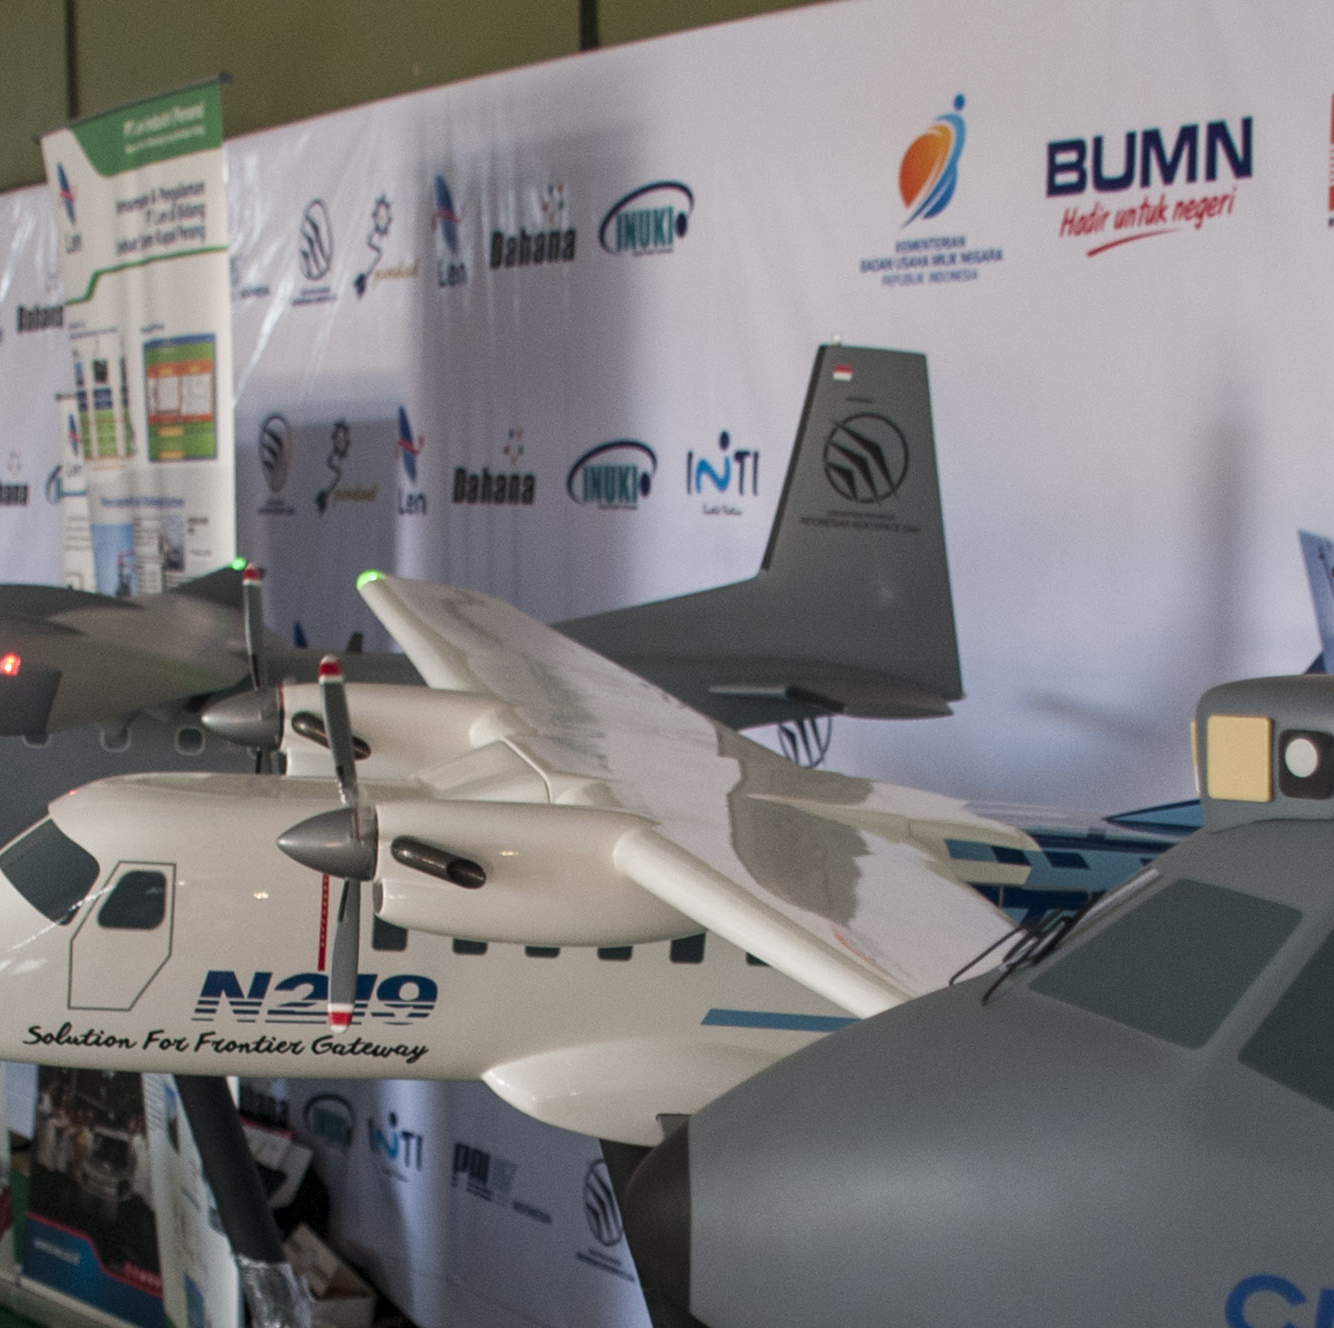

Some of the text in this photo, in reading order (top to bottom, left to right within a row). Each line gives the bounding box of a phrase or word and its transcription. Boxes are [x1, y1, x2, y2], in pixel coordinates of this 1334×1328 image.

[1046, 115, 1254, 198] BUMN
[615, 204, 674, 251] INUKI
[1059, 186, 1238, 239] Hadir untuk negeri
[489, 226, 576, 270] Dahana
[437, 258, 466, 288] Len
[451, 466, 536, 505] Dahana
[582, 463, 639, 503] INUKI
[686, 448, 760, 497] INTI
[397, 489, 427, 516] Len
[22, 1021, 429, 1064] Solution For Frontier Gateway
